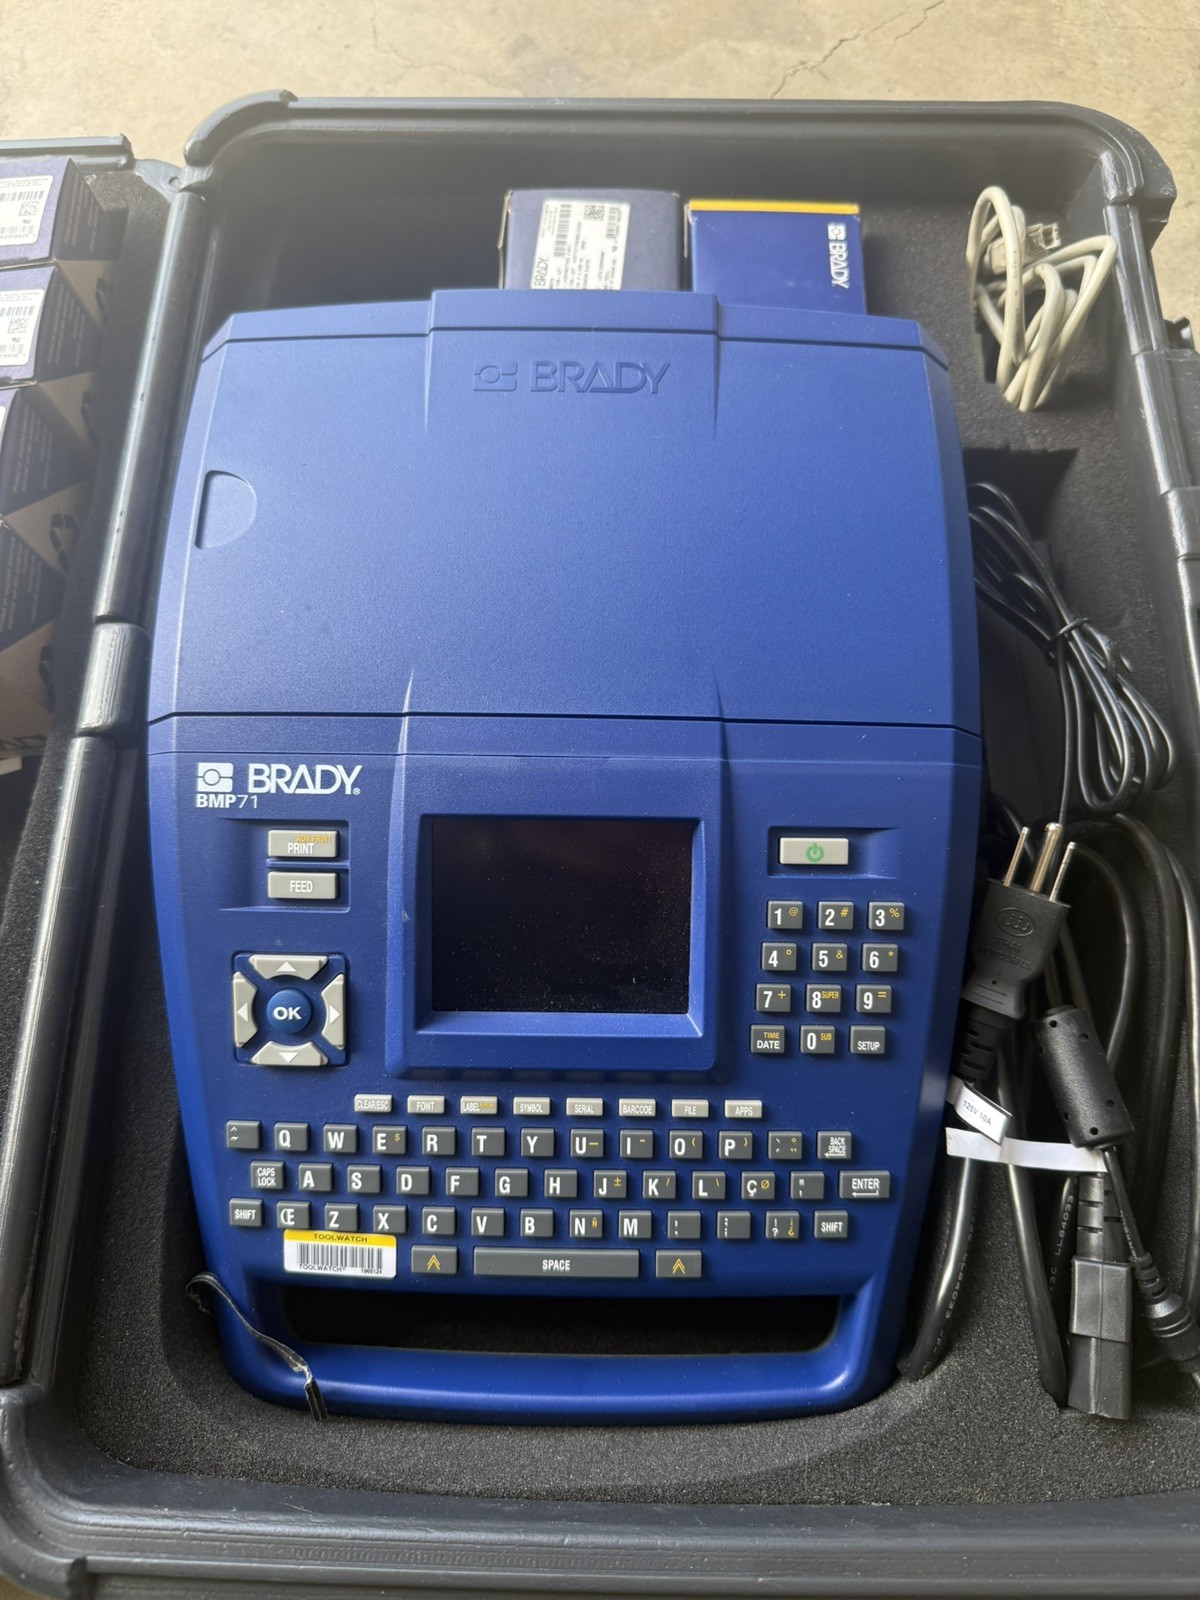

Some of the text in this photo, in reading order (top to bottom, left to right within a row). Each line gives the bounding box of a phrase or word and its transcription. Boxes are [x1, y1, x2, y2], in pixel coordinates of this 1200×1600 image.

[828, 240, 850, 289] BRADY
[530, 361, 670, 395] BRADY
[196, 794, 258, 809] BMP71
[287, 842, 315, 855] PRINT
[290, 880, 314, 893] FEED
[774, 908, 782, 926] 1
[824, 908, 835, 927] 2
[875, 909, 885, 927] 3
[768, 950, 778, 968] 4
[818, 950, 829, 968] 5
[869, 951, 879, 969] 6
[763, 991, 773, 1009] 7
[812, 990, 840, 1009] 8 SUPER
[863, 992, 873, 1010] 9
[271, 1006, 302, 1020] OK
[756, 1039, 781, 1050] DATE
[763, 1031, 780, 1040] TIME
[806, 1032, 832, 1050] 0 SUB
[857, 1041, 881, 1051] SETUP
[416, 1101, 436, 1111] FONT
[463, 1102, 480, 1113] LABEL
[519, 1103, 544, 1114] SYMBOL
[574, 1104, 595, 1115] SERIAL
[622, 1104, 653, 1115] BARCODE
[684, 1105, 697, 1115] FILE
[734, 1106, 754, 1117] APPS
[962, 1100, 992, 1126] 125V 10A
[278, 1129, 292, 1148] Q
[327, 1131, 345, 1149] W
[376, 1133, 387, 1151] E
[426, 1134, 438, 1152] R
[476, 1135, 487, 1153] T
[526, 1135, 538, 1154] Y
[575, 1136, 587, 1155] U
[724, 1138, 736, 1157] P
[829, 1136, 846, 1146] BACK
[828, 1145, 847, 1154] SPACE
[257, 1167, 276, 1177] CAPS
[302, 1170, 315, 1188] A
[351, 1171, 362, 1190] S
[257, 1176, 277, 1187] LOCK
[400, 1174, 413, 1191] D
[450, 1175, 461, 1193] F
[498, 1176, 511, 1195] G
[549, 1176, 561, 1195] H
[598, 1177, 608, 1196] J
[648, 1178, 659, 1197] K
[698, 1179, 708, 1197] L
[851, 1178, 880, 1190] ENTER
[234, 1208, 257, 1221] SHIFT
[328, 1211, 340, 1229] Z
[377, 1212, 390, 1231] X
[426, 1214, 438, 1233] C
[476, 1216, 488, 1234] V
[524, 1216, 536, 1234] B
[574, 1217, 586, 1236] N
[623, 1218, 639, 1236] M
[820, 1221, 844, 1233] SHIFT
[313, 1233, 368, 1243] TOOLWATCH
[542, 1259, 571, 1272] SPACE
